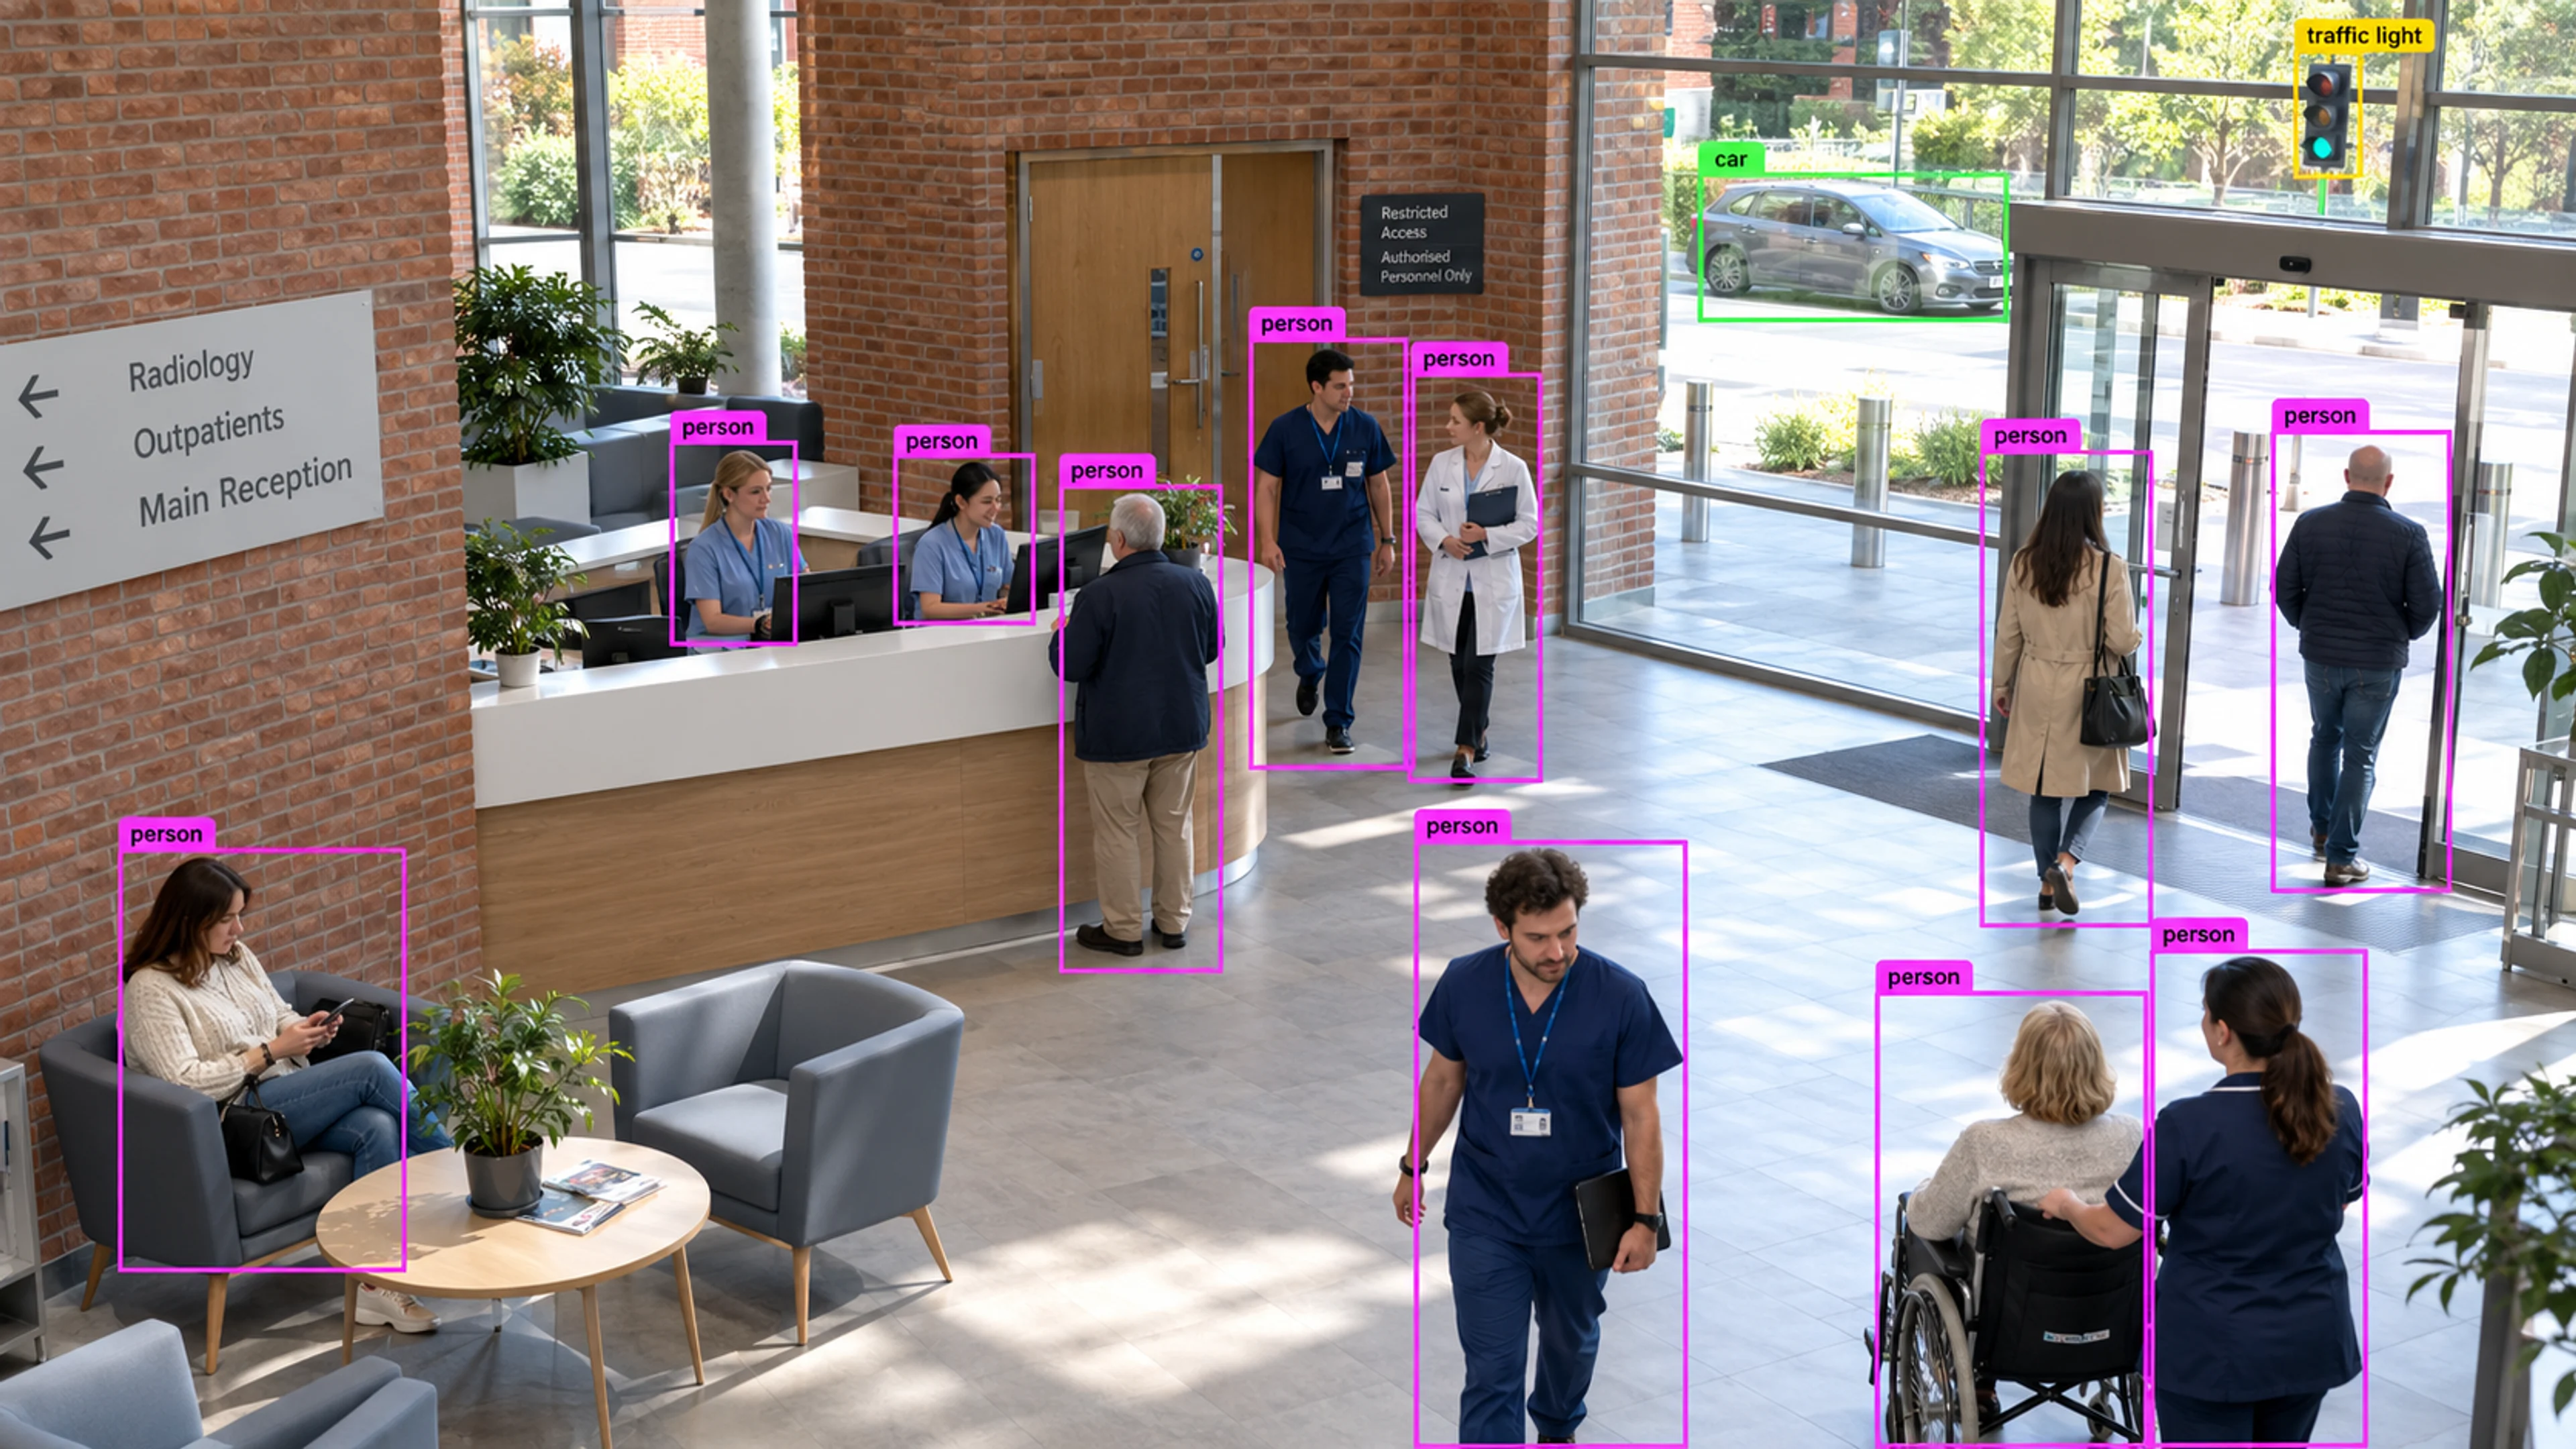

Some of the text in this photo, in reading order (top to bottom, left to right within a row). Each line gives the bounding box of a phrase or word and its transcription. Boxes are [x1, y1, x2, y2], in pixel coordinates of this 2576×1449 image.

[1381, 205, 1448, 219] Restricted
[1381, 226, 1428, 239] Access
[1381, 250, 1451, 264] Authorised
[1381, 268, 1472, 284] Personnel Only
[129, 349, 254, 392] Radiology
[134, 406, 284, 459] Outpatients
[140, 457, 353, 527] Main Reception
